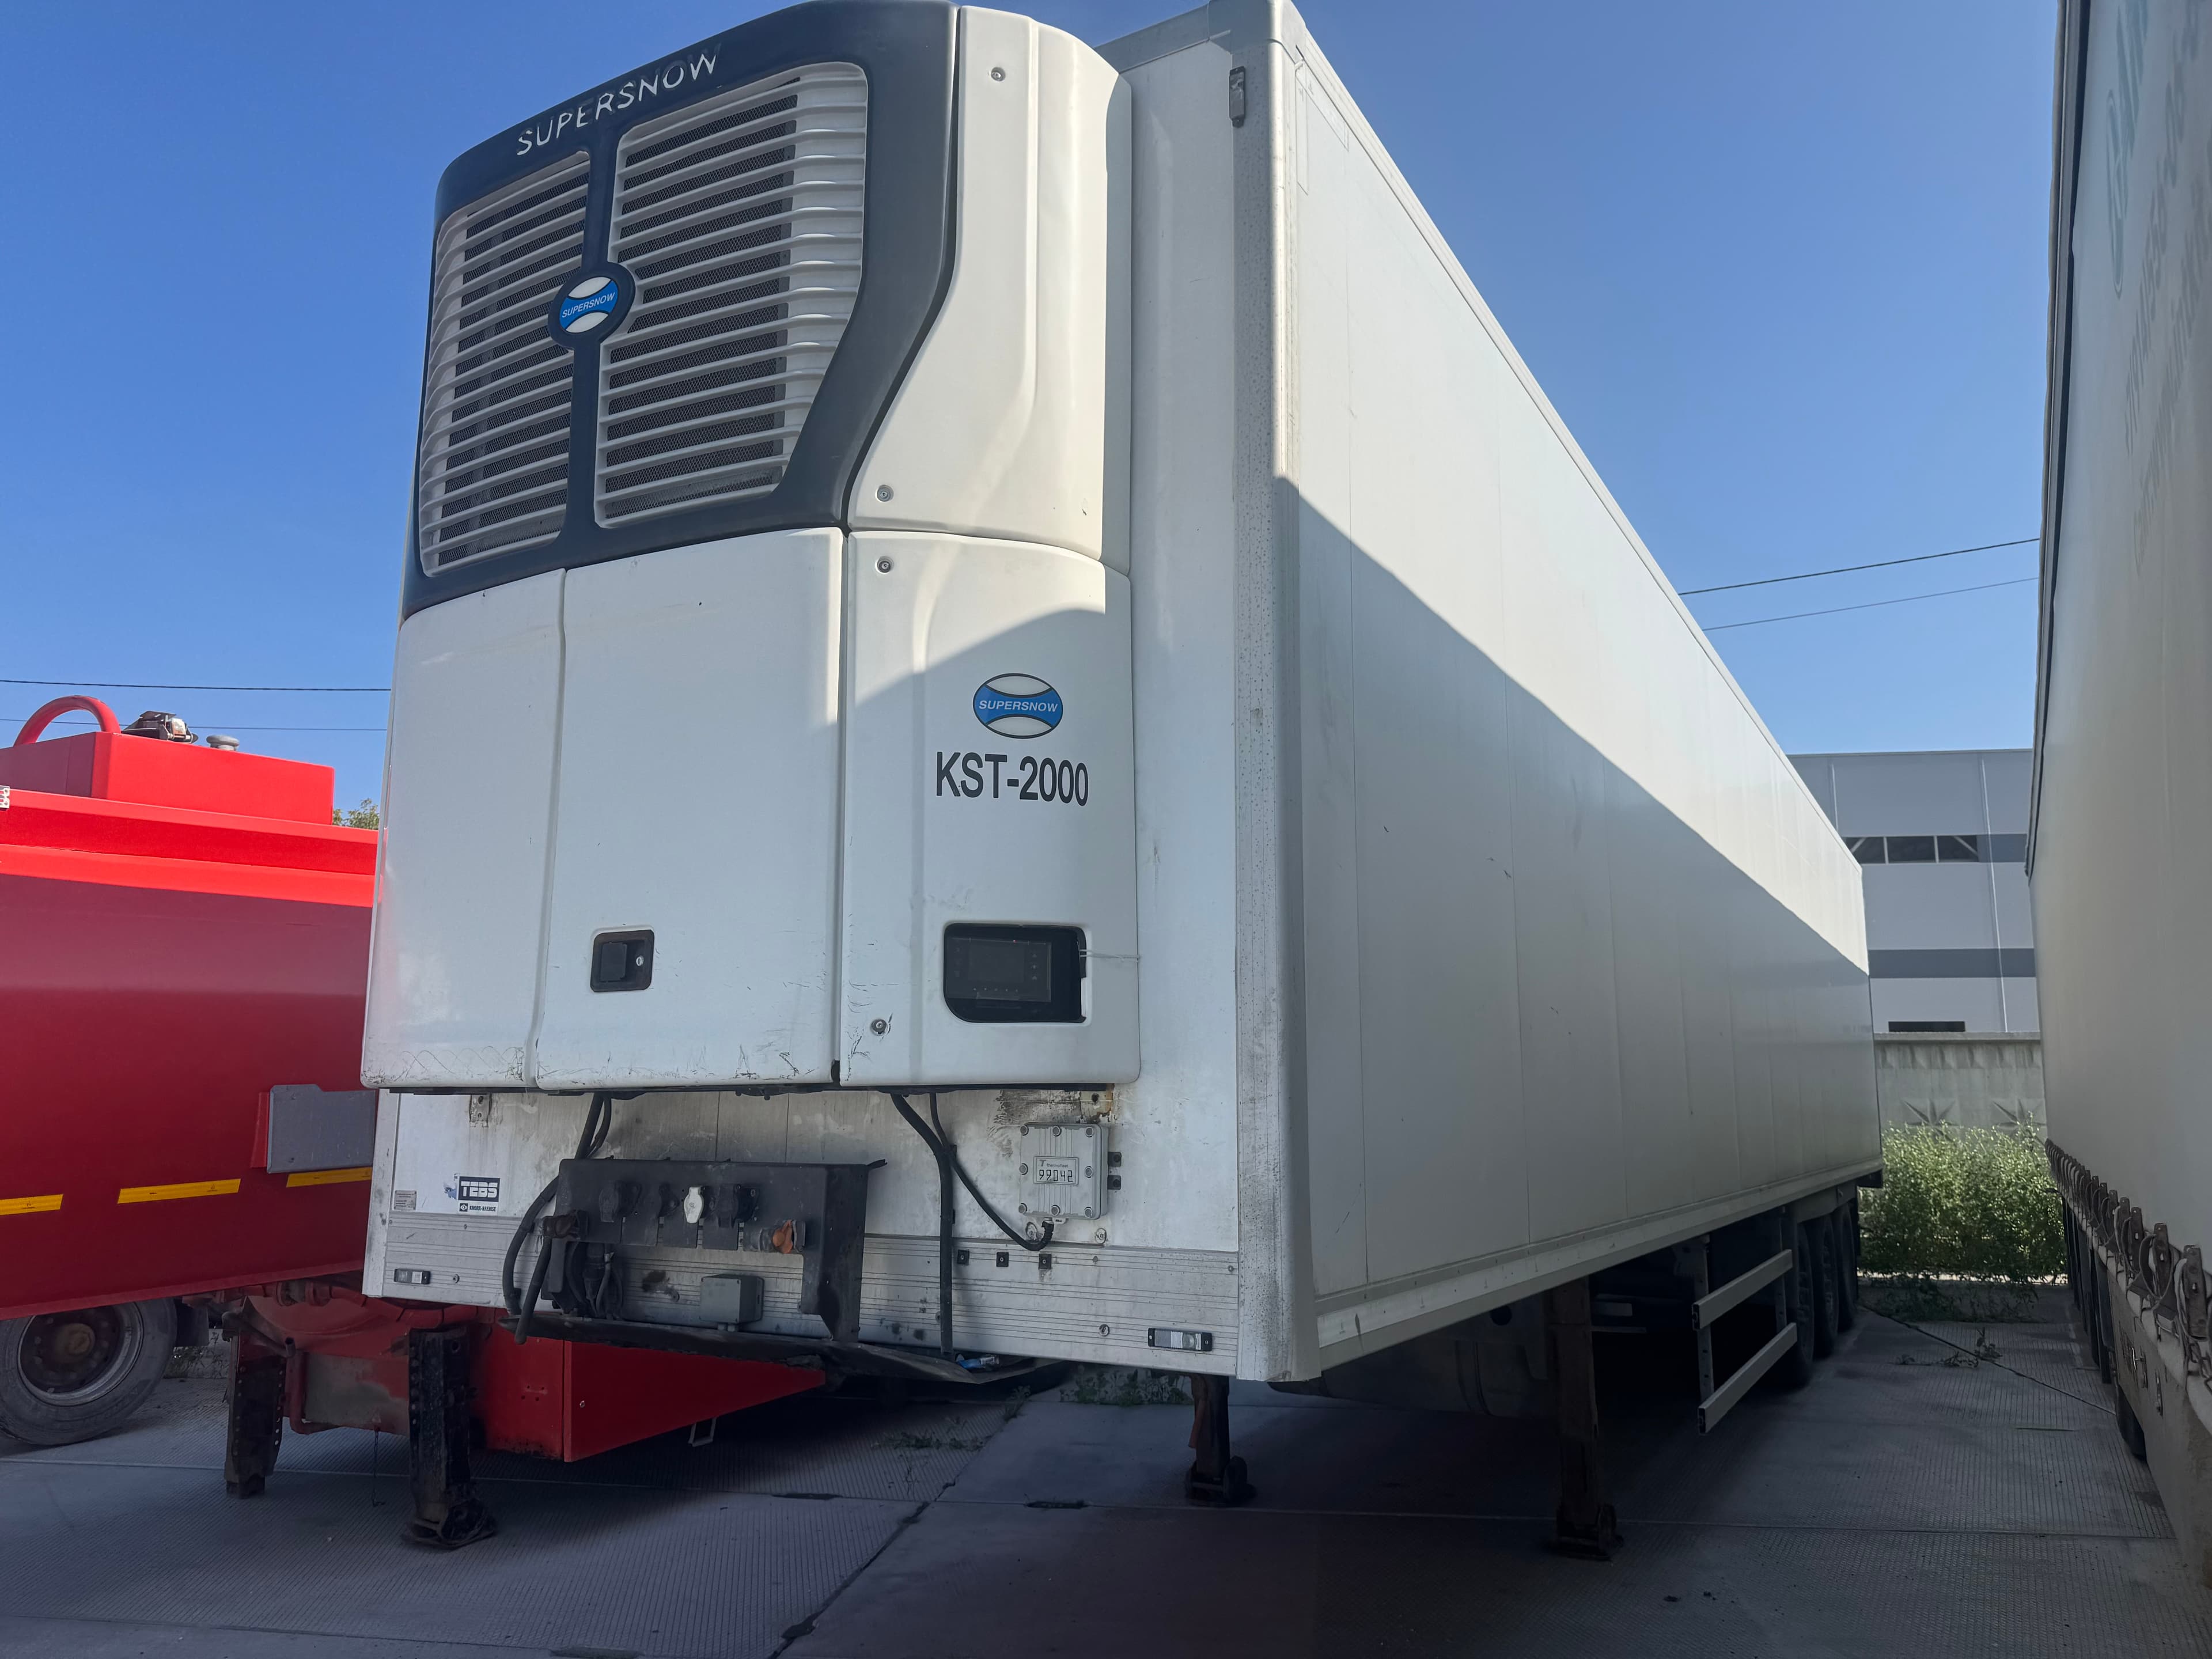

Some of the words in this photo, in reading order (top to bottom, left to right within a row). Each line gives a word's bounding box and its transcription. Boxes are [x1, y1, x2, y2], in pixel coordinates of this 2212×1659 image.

[517, 54, 717, 156] SUPERSNOW
[562, 291, 616, 318] SUPERSNOW
[979, 700, 1058, 713] SUPERSNOW
[936, 751, 1089, 806] KST-2000
[1039, 1169, 1073, 1182] 99042
[461, 1181, 498, 1198] TEBS
